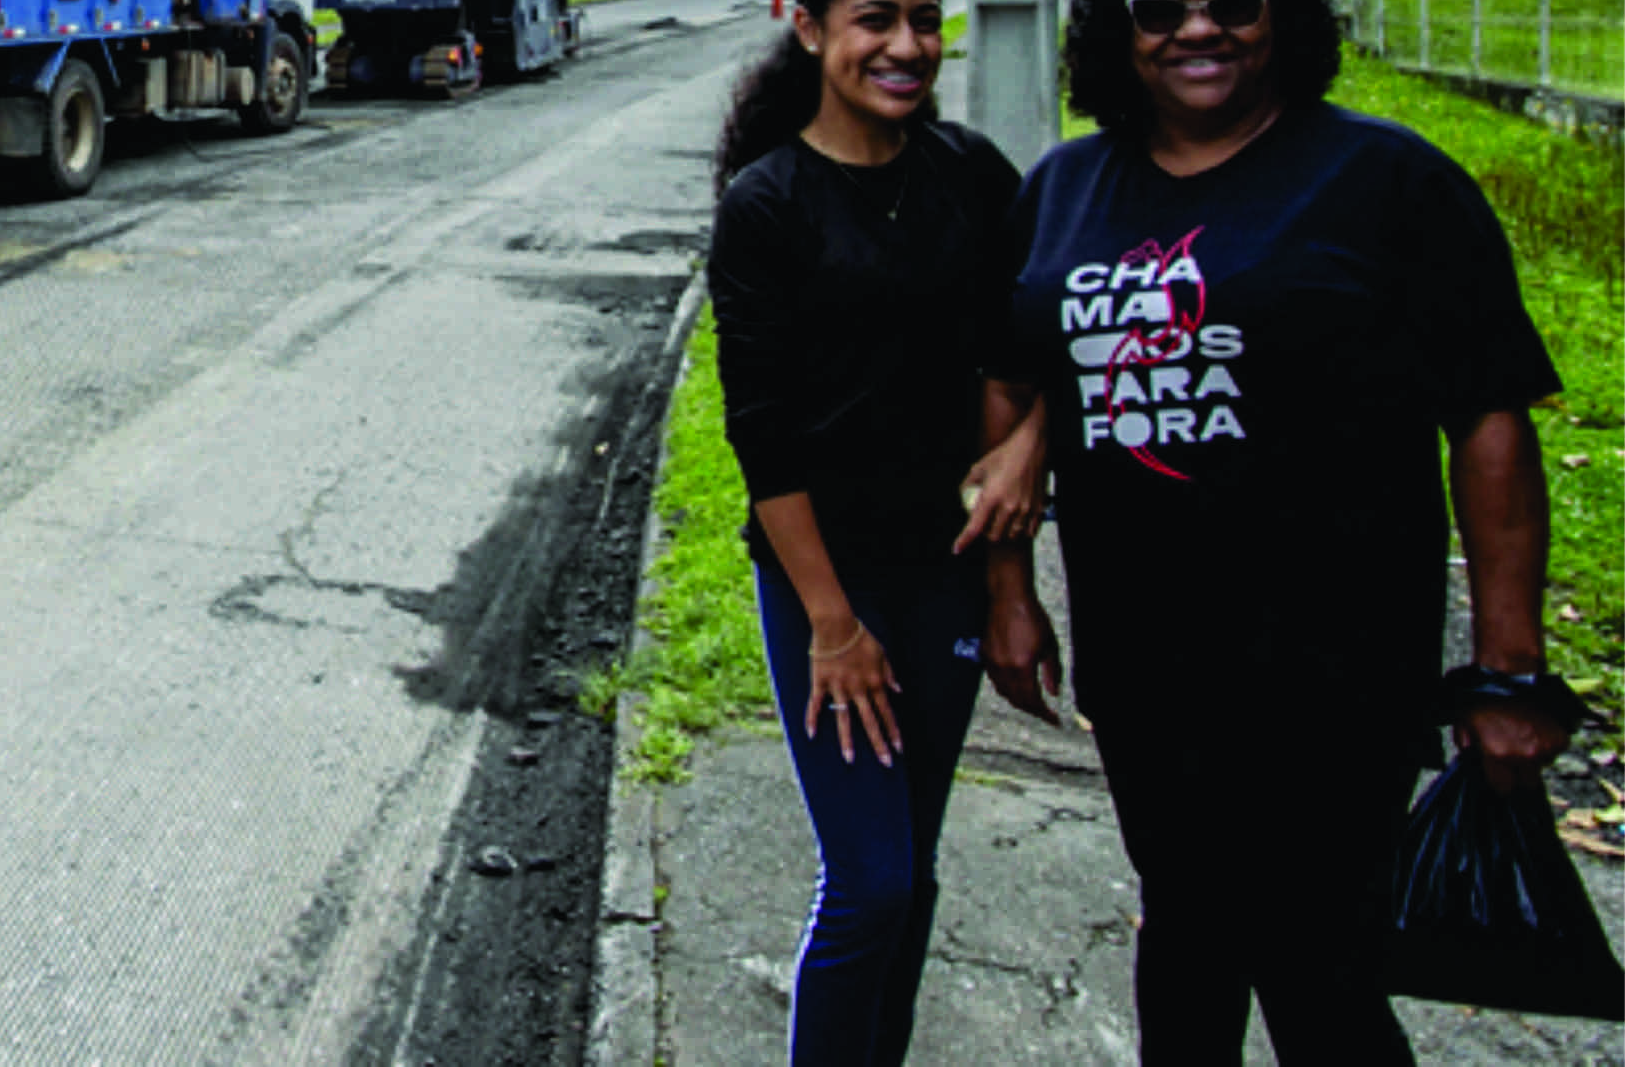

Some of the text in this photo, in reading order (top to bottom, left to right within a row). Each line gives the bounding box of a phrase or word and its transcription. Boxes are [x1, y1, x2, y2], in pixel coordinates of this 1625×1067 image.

[1065, 256, 1203, 294] CHA
[1077, 364, 1243, 409] PARA
[1081, 405, 1247, 450] FORA
